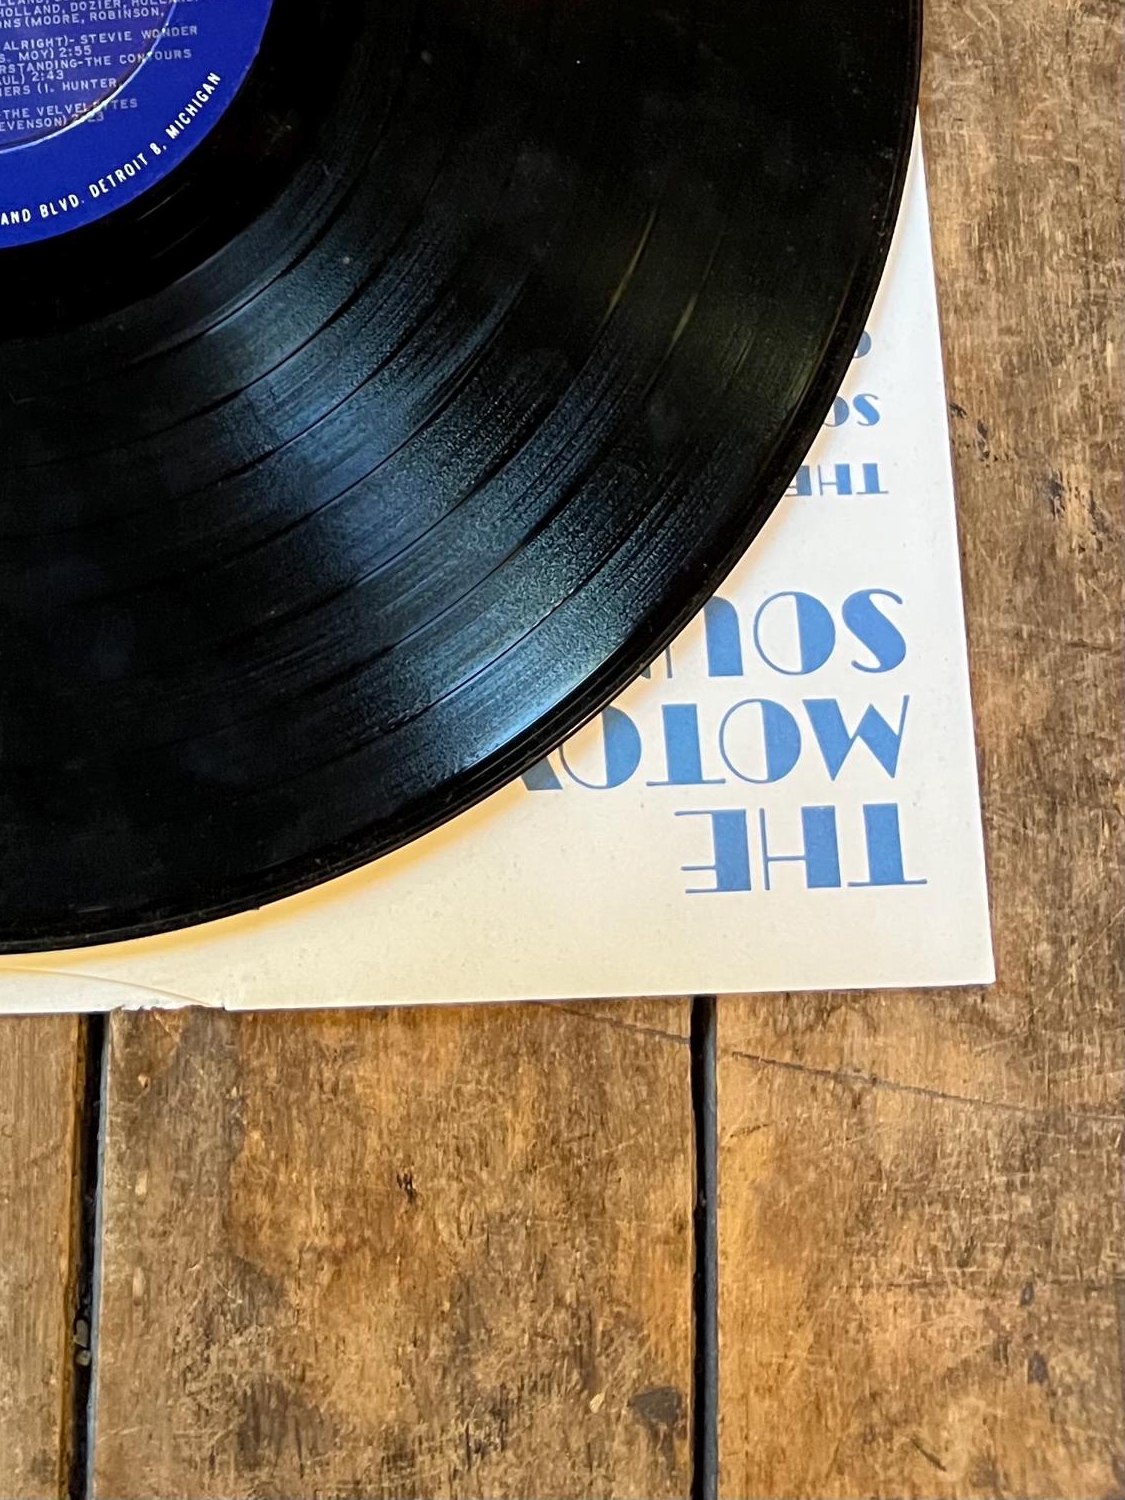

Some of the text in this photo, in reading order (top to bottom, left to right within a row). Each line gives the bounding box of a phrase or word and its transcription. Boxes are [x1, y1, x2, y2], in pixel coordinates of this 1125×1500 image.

[80, 31, 132, 45] STEVIE
[141, 25, 198, 40] WONDER
[90, 5, 164, 23] ROBINSON,
[31, 70, 64, 83] 2:43
[40, 194, 85, 218] BLVD.
[89, 153, 149, 197] DETROIT
[149, 142, 167, 156] 8,
[165, 72, 221, 140] MICHIGAN
[784, 462, 888, 498] THE
[638, 588, 908, 679] SOU
[519, 695, 910, 791] MOTO
[674, 802, 928, 894] THE
